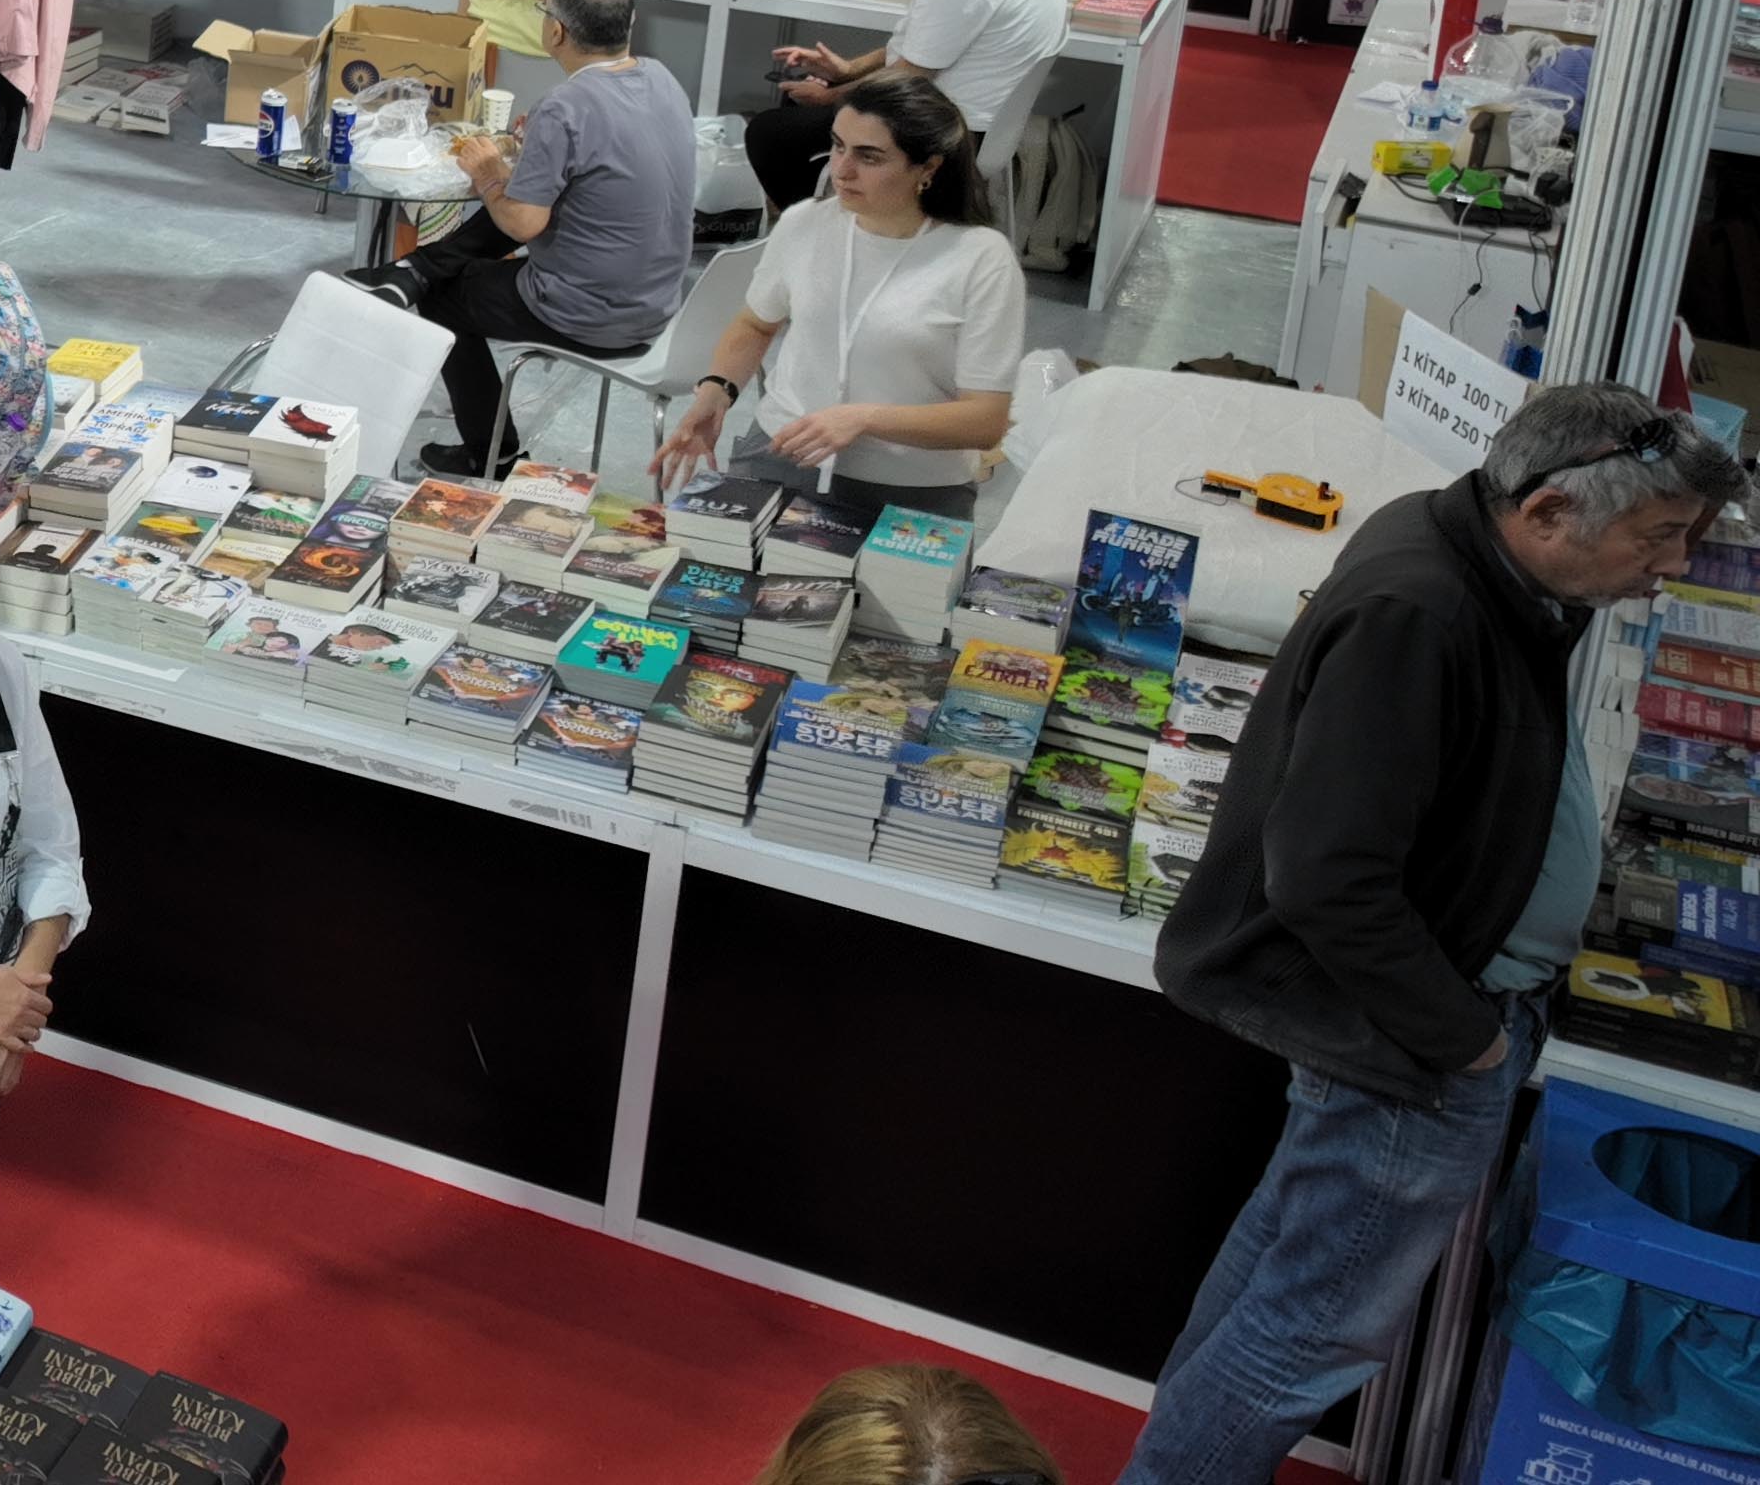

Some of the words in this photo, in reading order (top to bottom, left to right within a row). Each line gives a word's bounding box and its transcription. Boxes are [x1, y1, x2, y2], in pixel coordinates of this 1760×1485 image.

[1394, 378, 1404, 398] 3
[1407, 384, 1450, 426] KİTAP
[1451, 415, 1478, 446] 250
[1481, 431, 1496, 454] T
[1402, 344, 1411, 363] 1
[1414, 350, 1457, 389] KİTAP
[1463, 382, 1490, 413] 100
[1494, 399, 1509, 425] TL
[42, 1347, 117, 1389] KAPANI
[43, 1363, 104, 1398] BÜLBÜL
[1537, 1412, 1589, 1439] YALNIZCA
[1591, 1427, 1617, 1445] GERİ
[1616, 1434, 1699, 1469] KAZANILABİLİR
[1699, 1461, 1746, 1485] ATIKLAR
